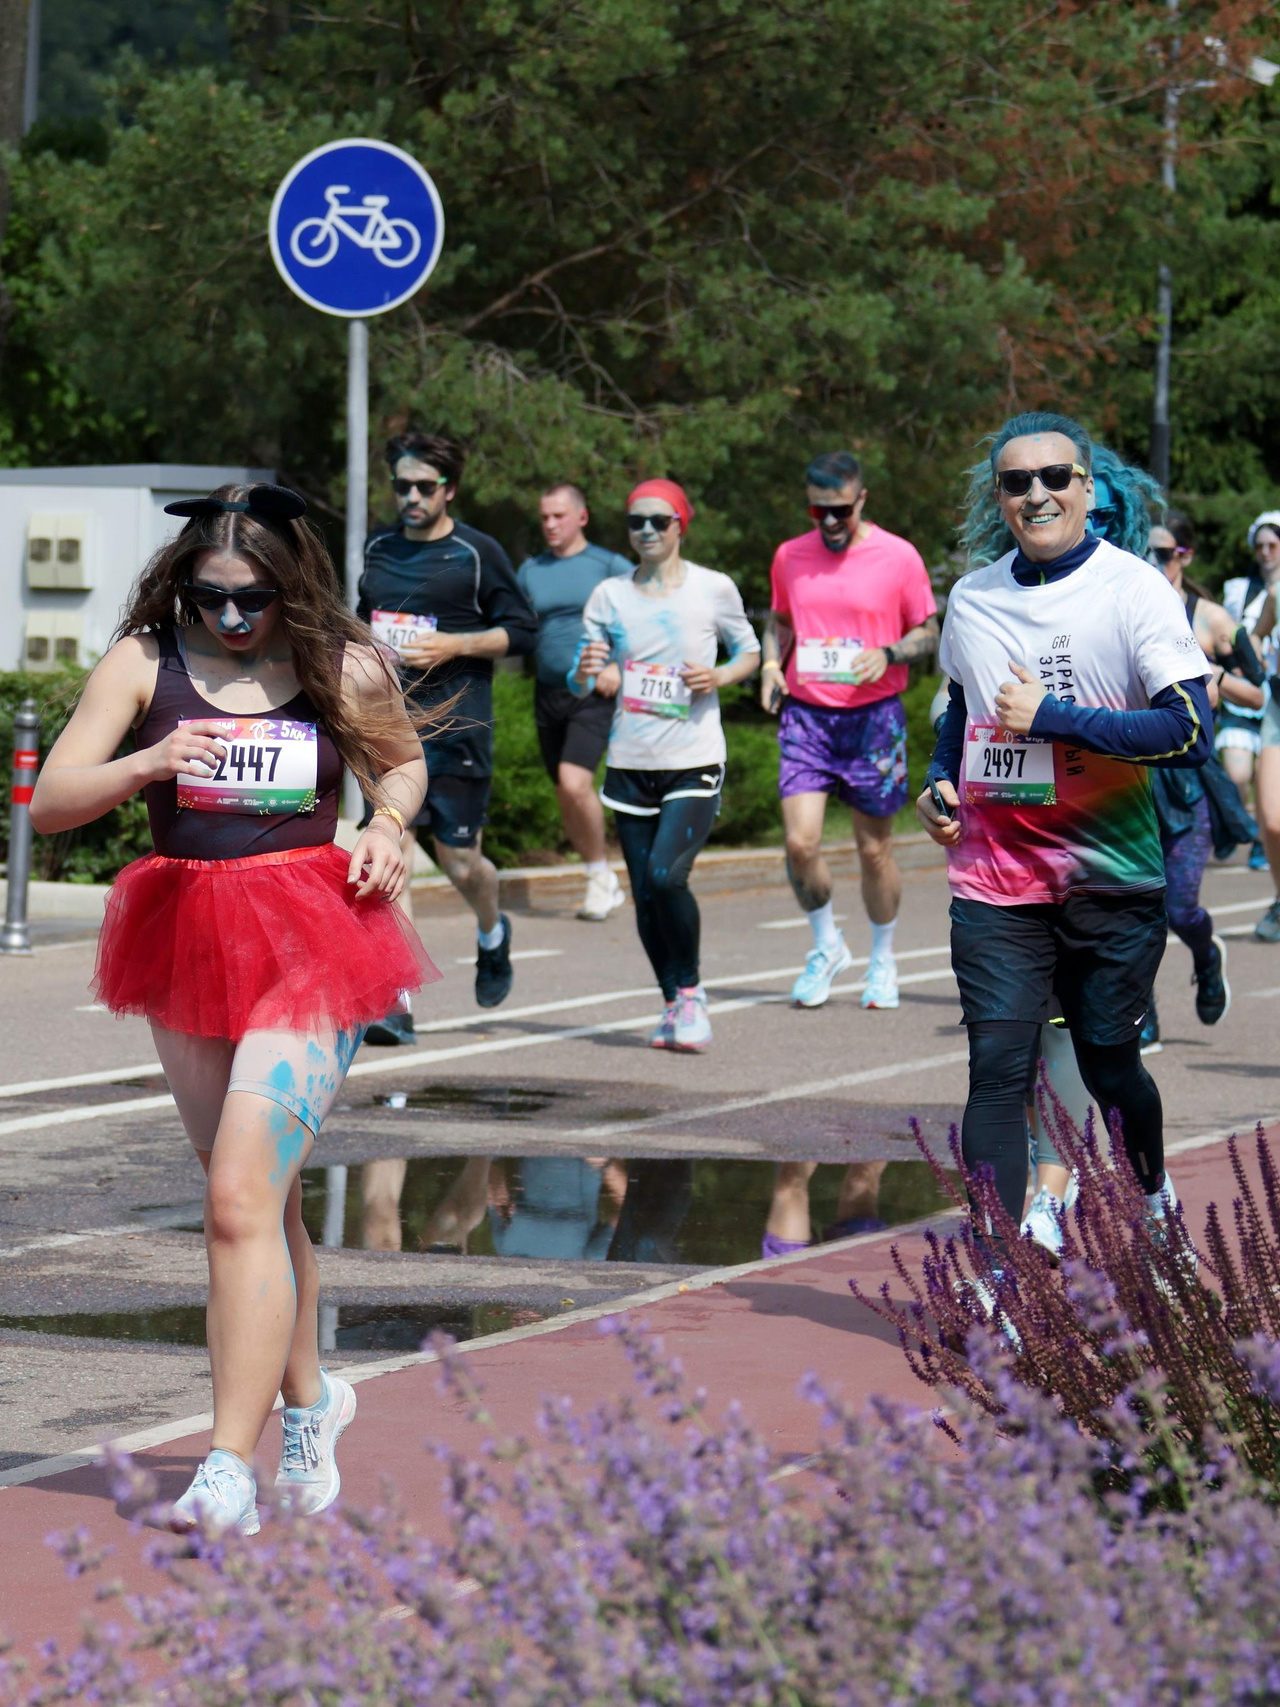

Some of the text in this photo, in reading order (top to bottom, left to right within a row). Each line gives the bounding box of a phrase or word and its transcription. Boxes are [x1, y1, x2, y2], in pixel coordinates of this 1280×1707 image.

[822, 650, 839, 669] 39
[640, 677, 672, 699] 2718
[213, 744, 282, 782] 2447
[983, 747, 1028, 778] 2497
